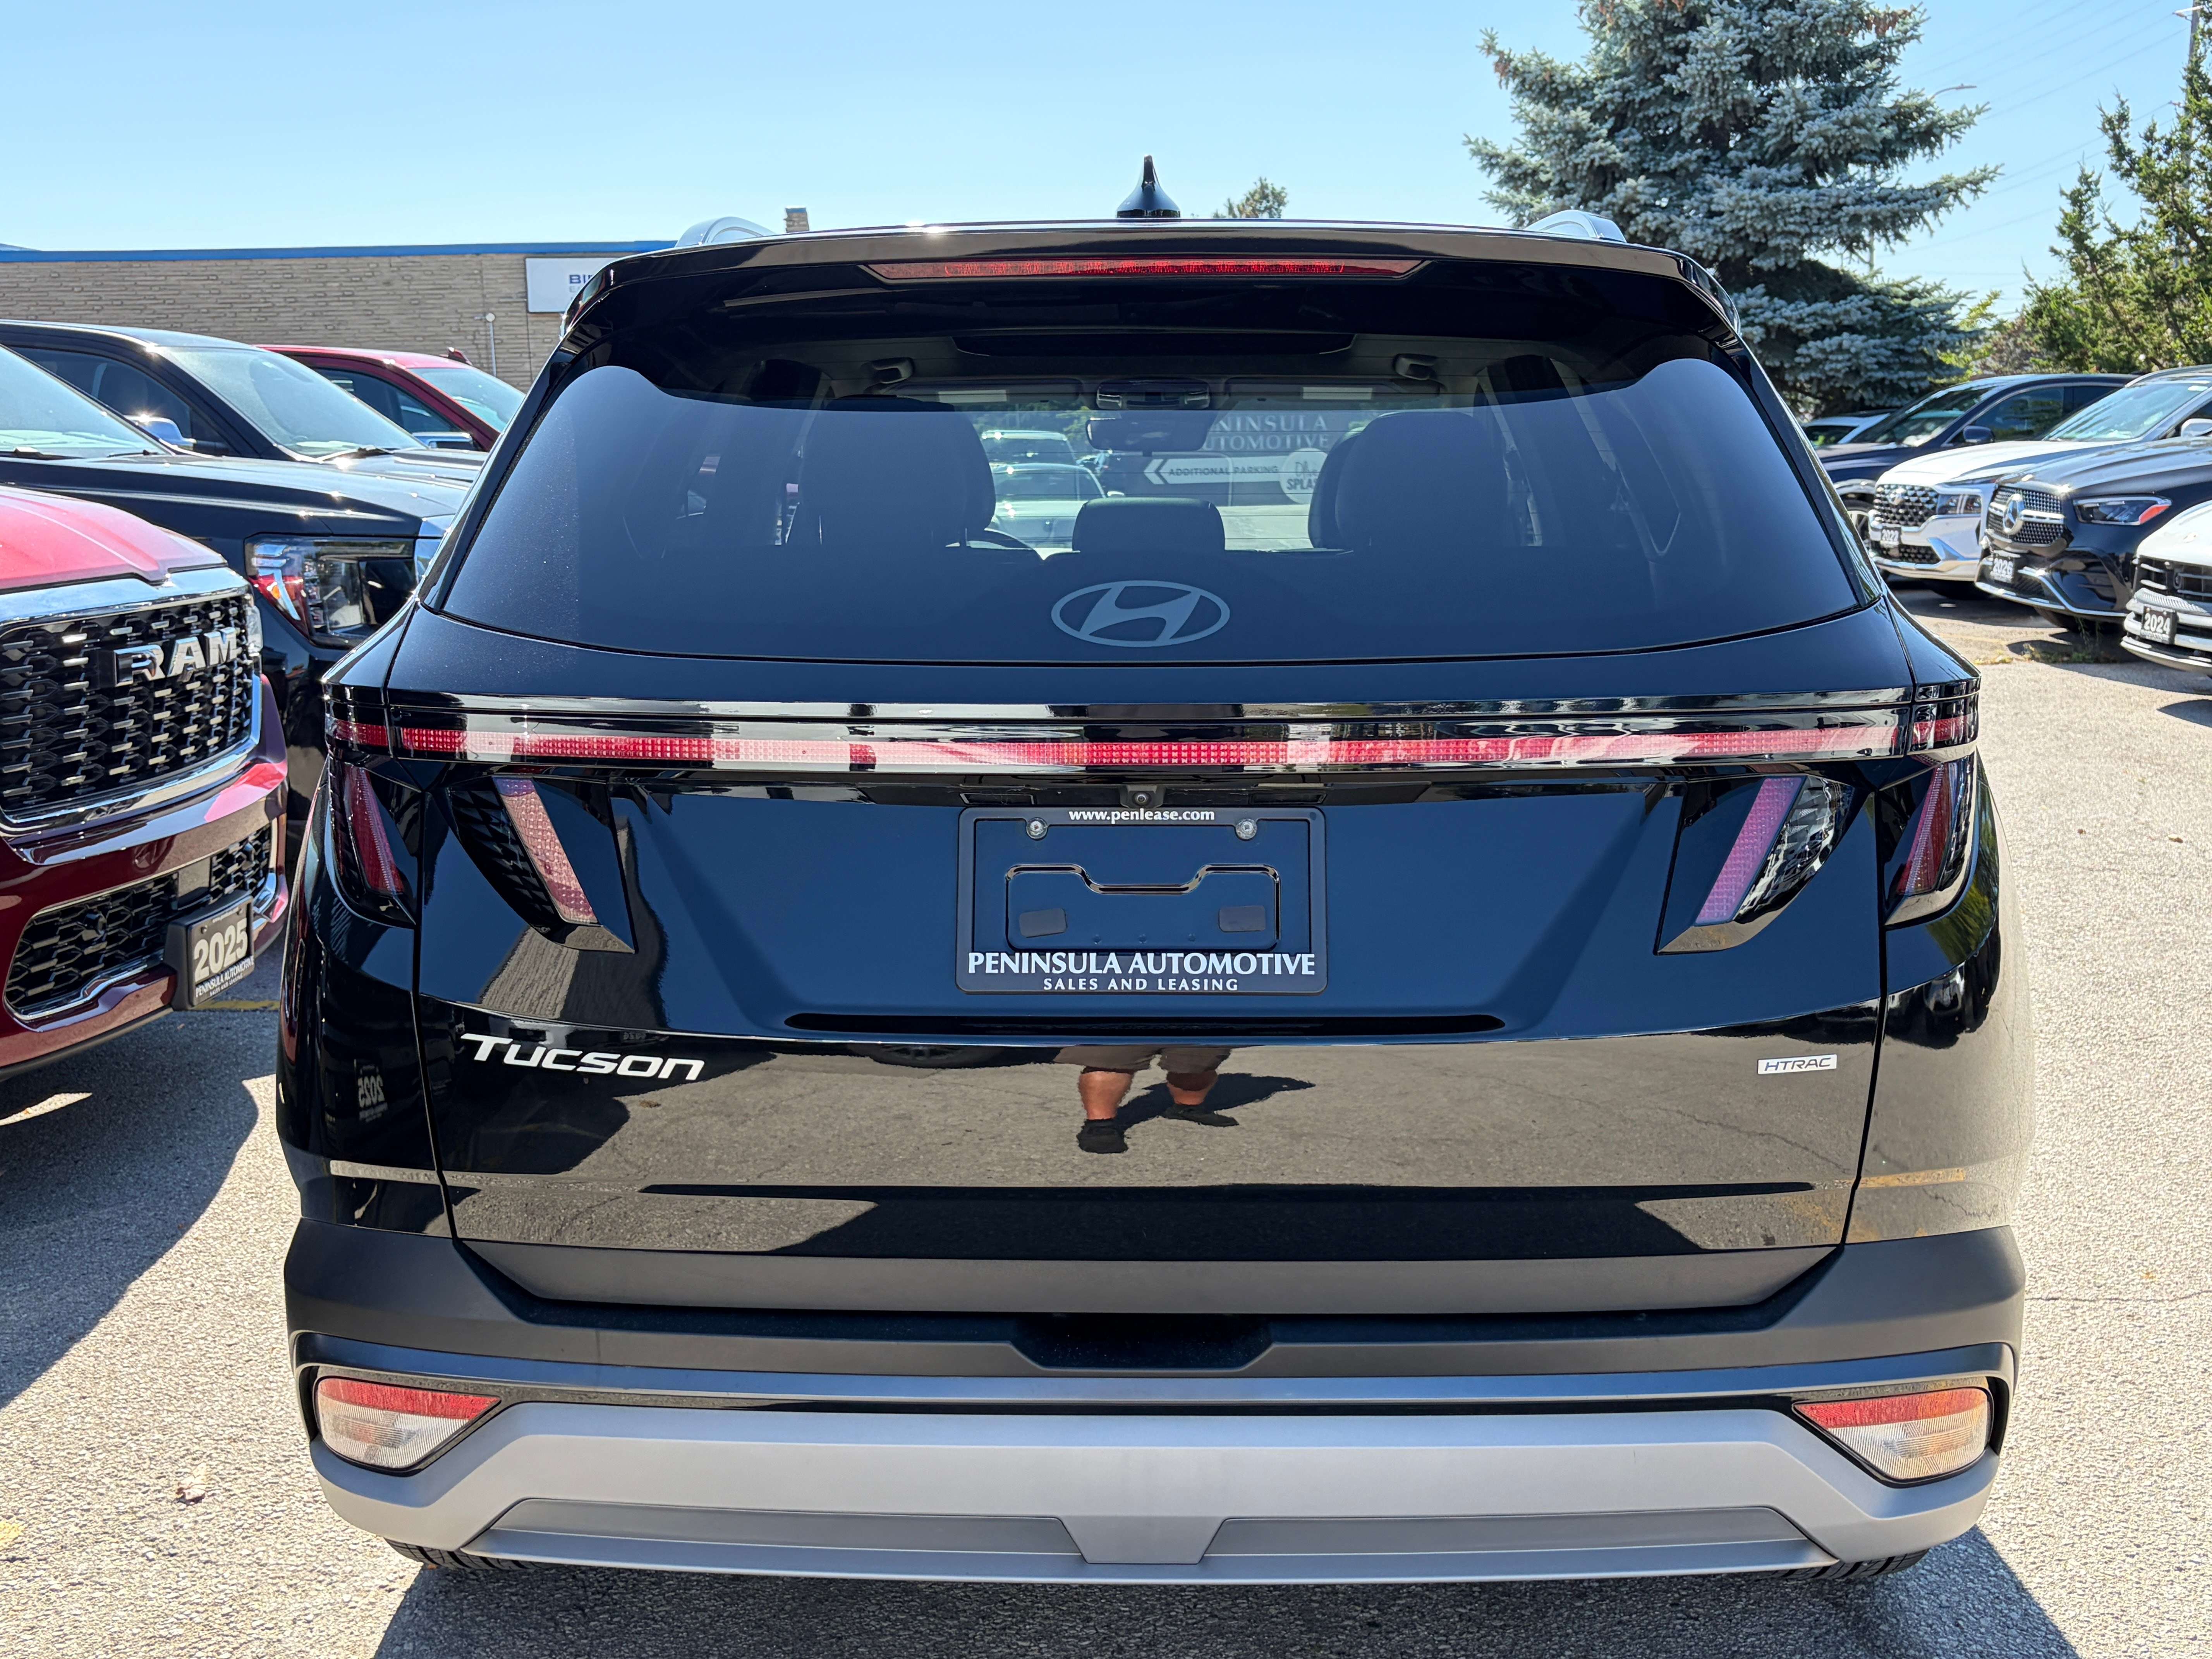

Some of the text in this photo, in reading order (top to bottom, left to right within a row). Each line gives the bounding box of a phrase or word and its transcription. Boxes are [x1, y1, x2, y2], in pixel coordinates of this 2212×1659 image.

[569, 275, 593, 283] BI
[1215, 415, 1328, 431] NINSULA
[1202, 433, 1330, 451] UTOMOTIVE
[1169, 465, 1278, 476] ADDITIONAL PARKING
[1993, 558, 2013, 576] 2026
[2144, 613, 2171, 634] 2024
[113, 627, 237, 687] RAM
[1068, 808, 1215, 824] www.penlease.com
[194, 918, 248, 982] 2025
[968, 952, 1315, 975] PENINSULA AUTOMOTIVE
[196, 955, 254, 998] PENINSULA AUTOMOTIVE
[1044, 978, 1238, 991] SALES AND LEASING
[1764, 1057, 1831, 1071] HTRAC
